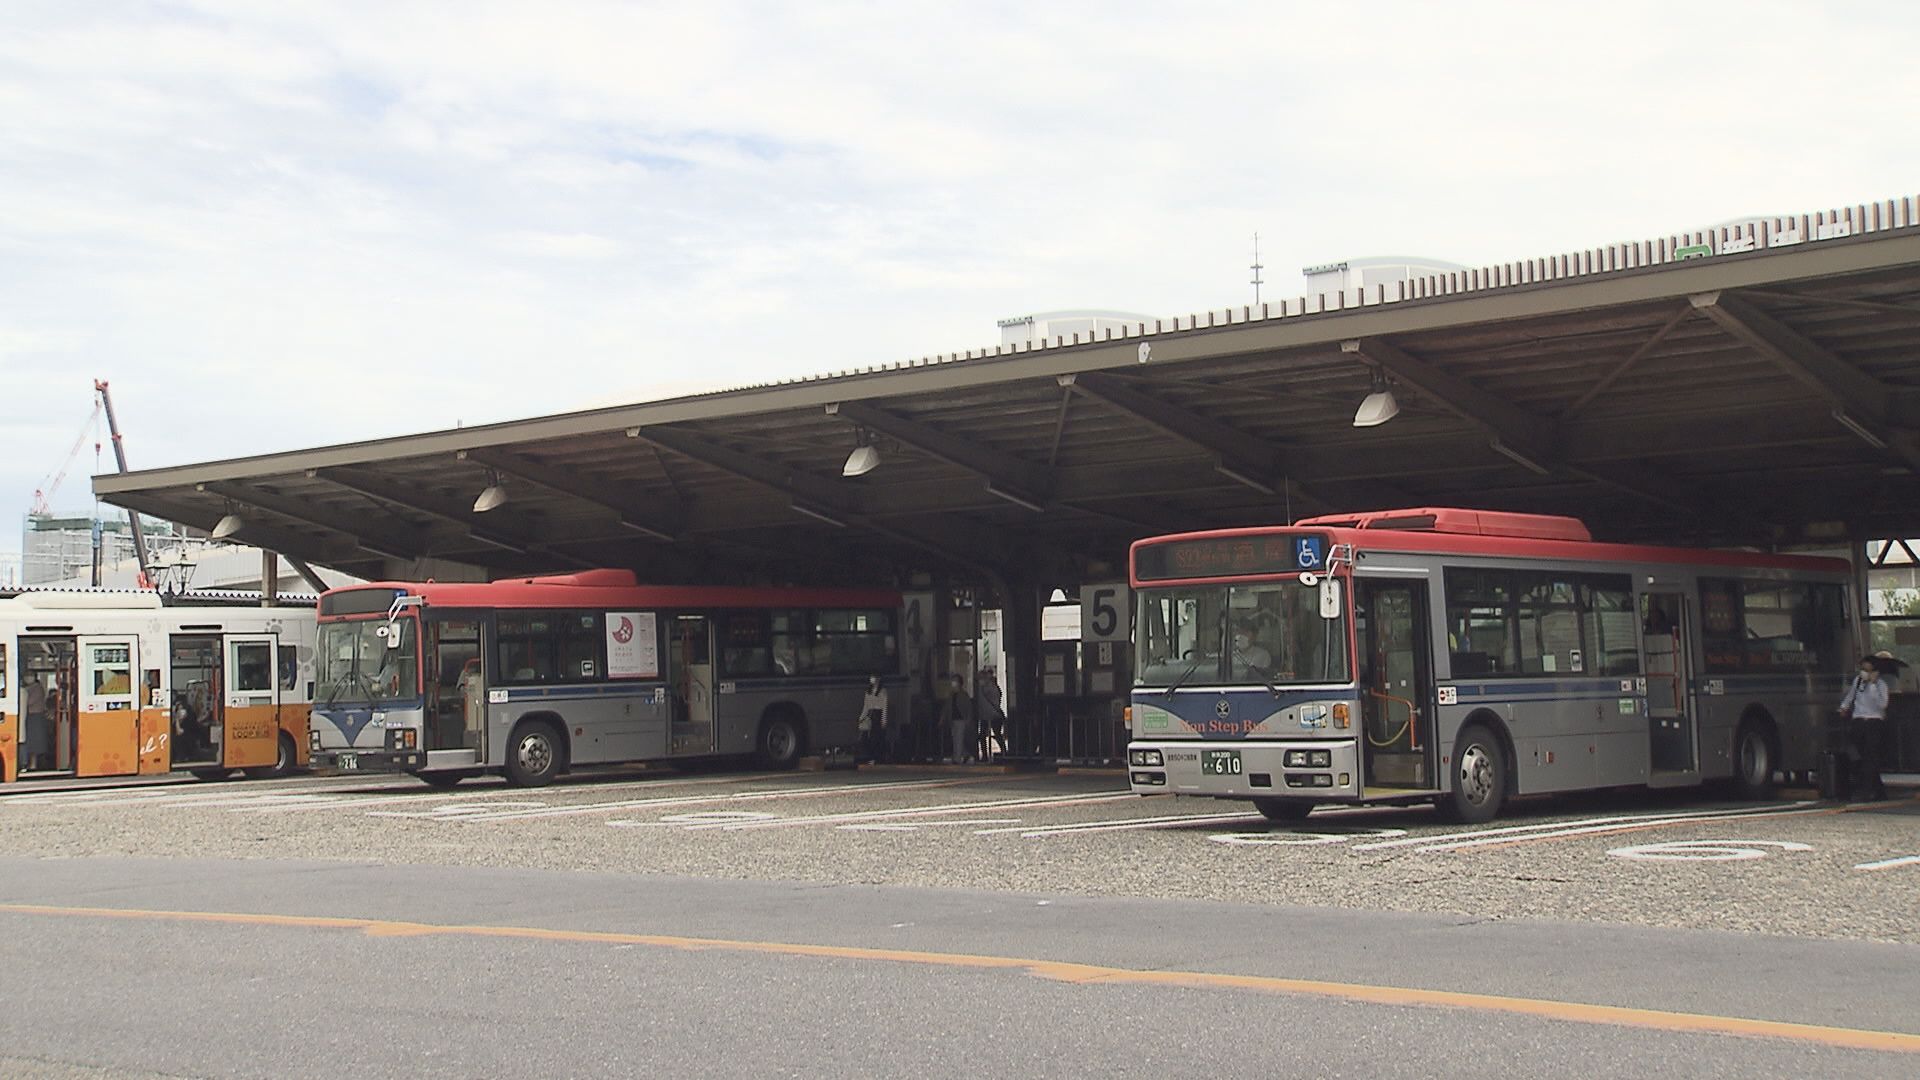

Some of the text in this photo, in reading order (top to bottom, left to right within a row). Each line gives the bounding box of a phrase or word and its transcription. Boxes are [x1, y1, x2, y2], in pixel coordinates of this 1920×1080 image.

[1092, 588, 1117, 637] 5
[1178, 720, 1205, 733] Non
[1208, 719, 1239, 736] Step
[1243, 719, 1270, 733] Bus
